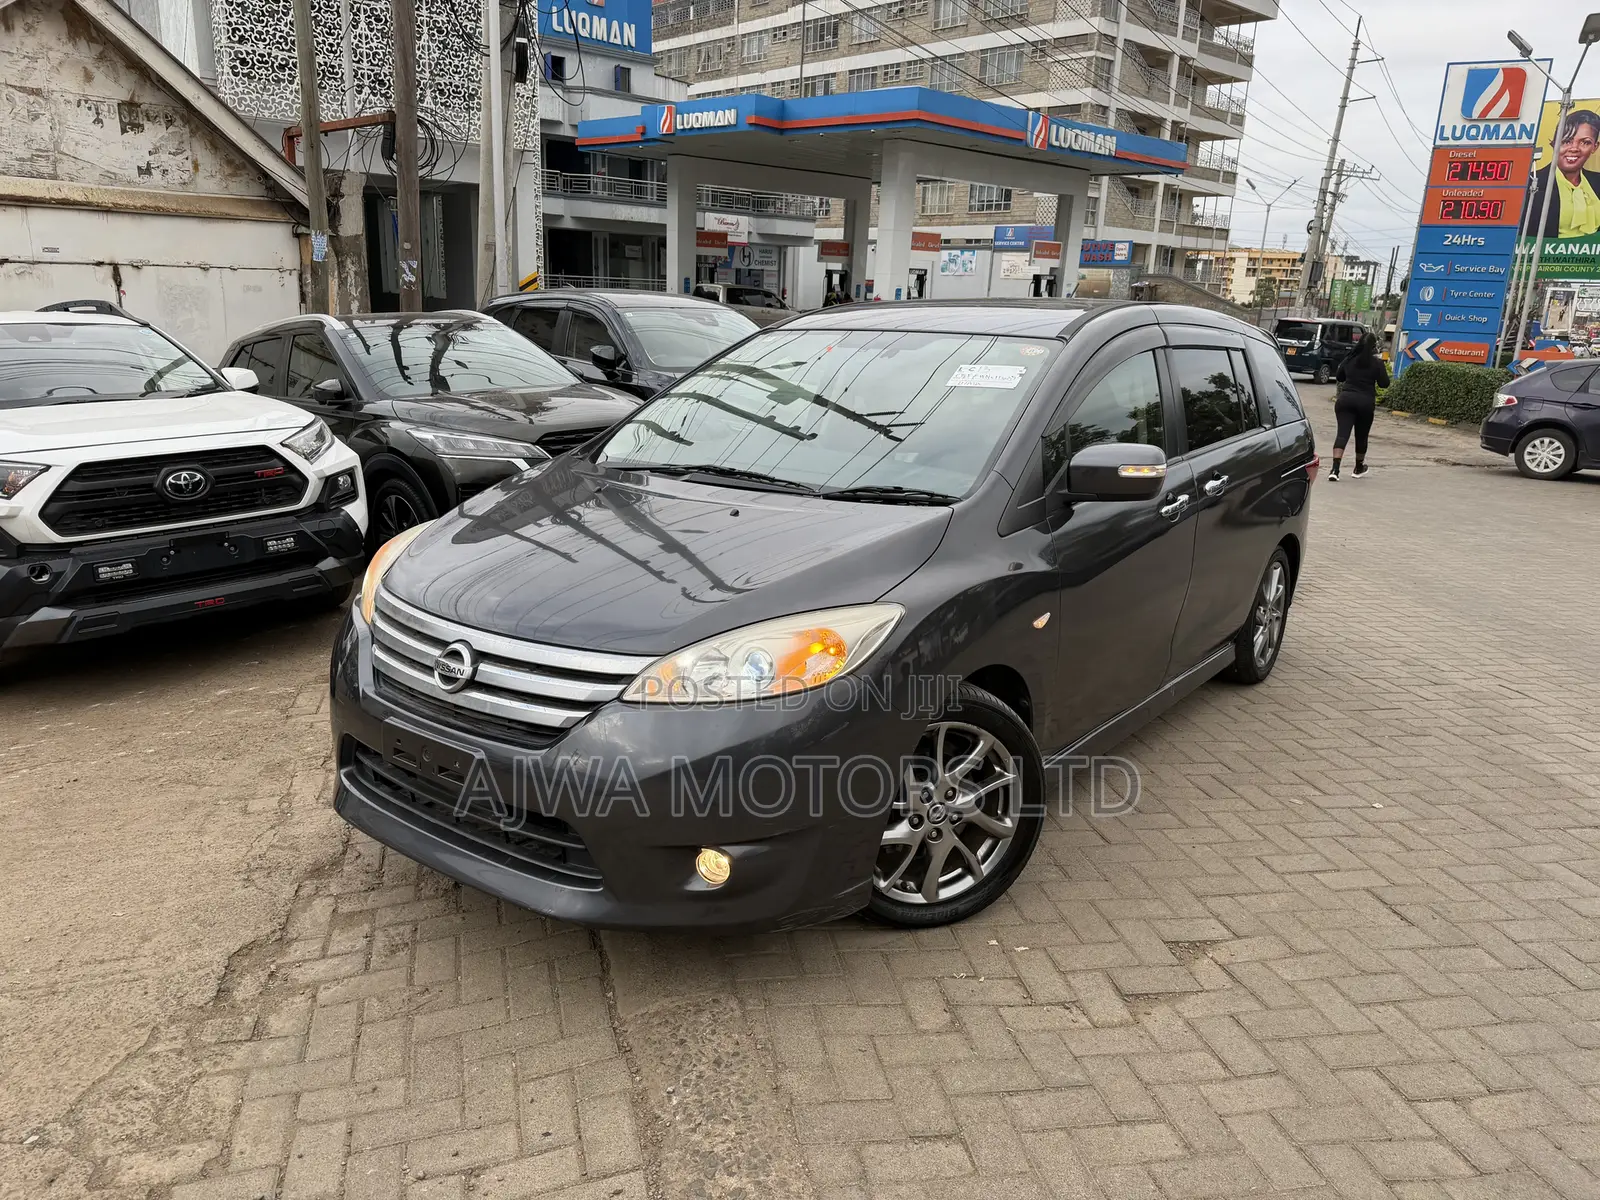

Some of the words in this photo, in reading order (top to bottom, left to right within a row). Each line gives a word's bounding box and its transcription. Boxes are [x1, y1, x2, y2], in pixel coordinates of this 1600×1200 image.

[551, 5, 636, 48] LUQMAN
[676, 108, 737, 130] LUQMAN
[1438, 123, 1535, 141] LUQMAN
[1049, 123, 1117, 157] LUQMAN
[1449, 150, 1477, 158] Diesel
[1442, 189, 1484, 197] Unleaded
[1443, 234, 1485, 246] 24Hrs
[1081, 243, 1115, 252] UTIVE
[1083, 253, 1113, 262] WASH
[1454, 264, 1487, 273] Service
[1488, 265, 1506, 275] Bay
[1450, 289, 1468, 299] Tyre
[1468, 290, 1495, 299] Center
[1444, 313, 1466, 322] Quick
[1468, 314, 1488, 324] Shop
[1439, 346, 1485, 357] Restaurant
[254, 466, 285, 478] TRD
[194, 597, 225, 608] TRD
[435, 658, 465, 677] NISSAN
